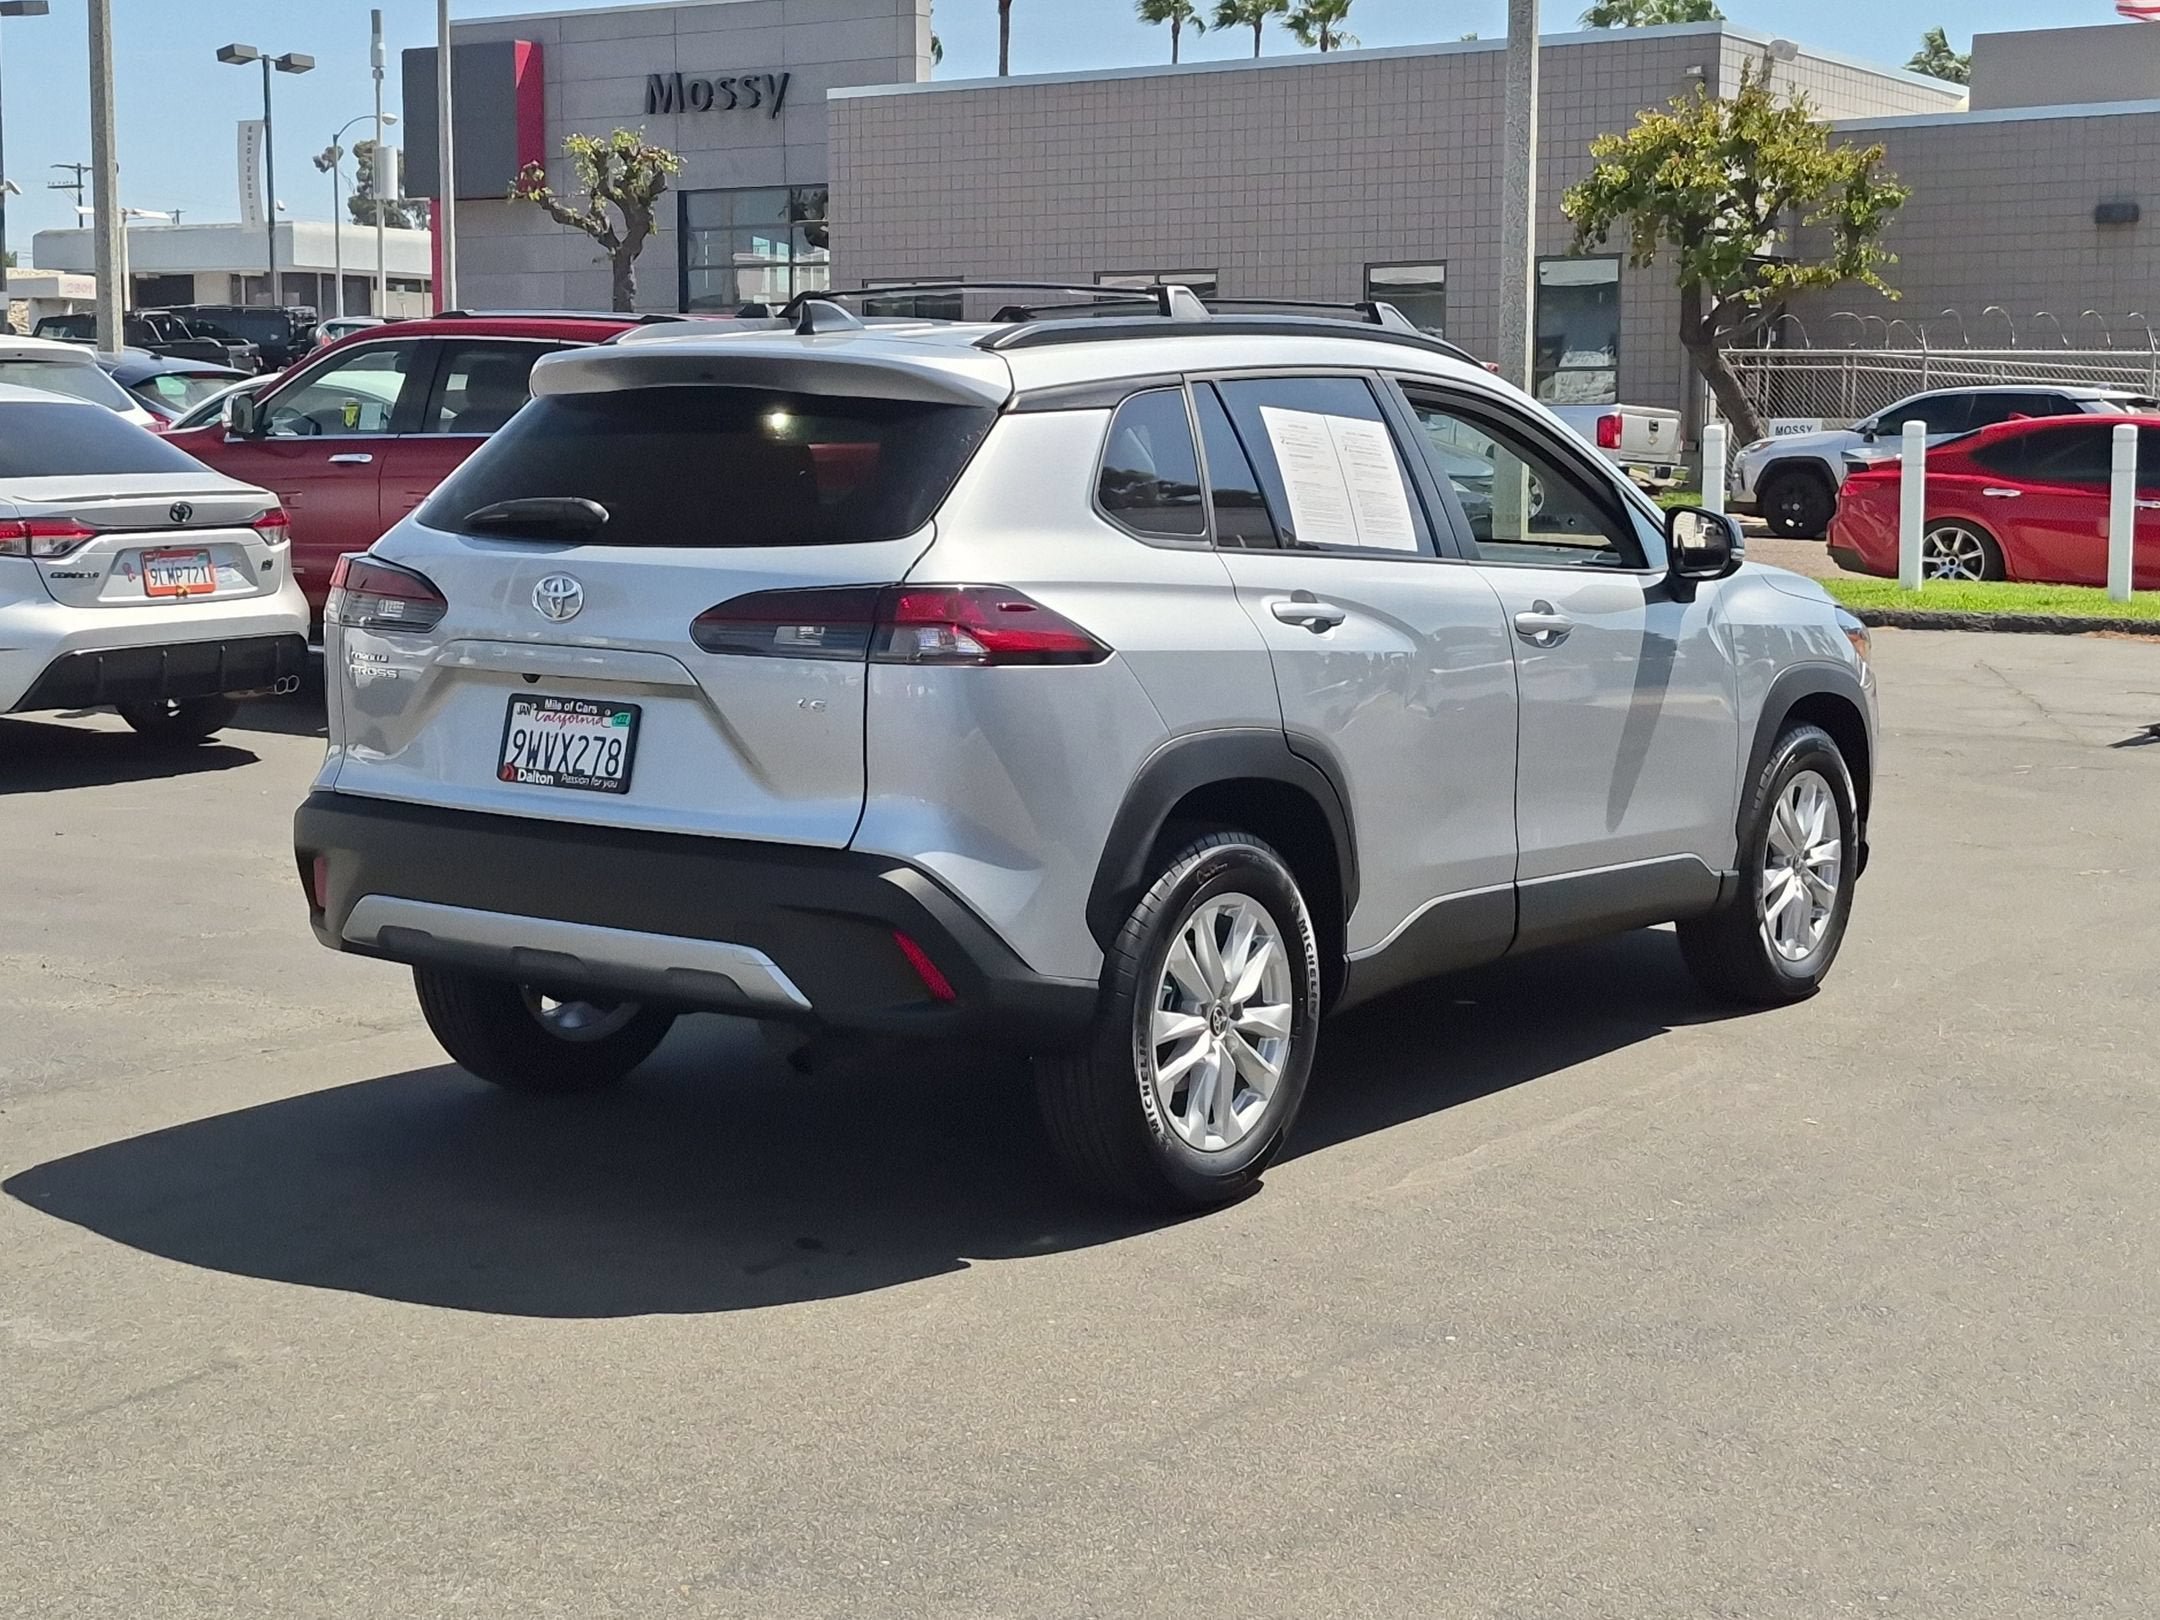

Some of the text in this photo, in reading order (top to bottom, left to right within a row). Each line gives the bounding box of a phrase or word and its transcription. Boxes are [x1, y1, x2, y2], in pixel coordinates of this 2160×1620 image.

[645, 72, 791, 120] Mossy
[1775, 424, 1813, 436] MOSSY
[150, 566, 208, 586] 9LMP721
[349, 664, 399, 679] CROSS
[545, 698, 598, 715] Mile of Cars
[511, 728, 622, 778] 9WVX278
[517, 768, 554, 785] Dalton
[561, 773, 618, 789] Passion for you
